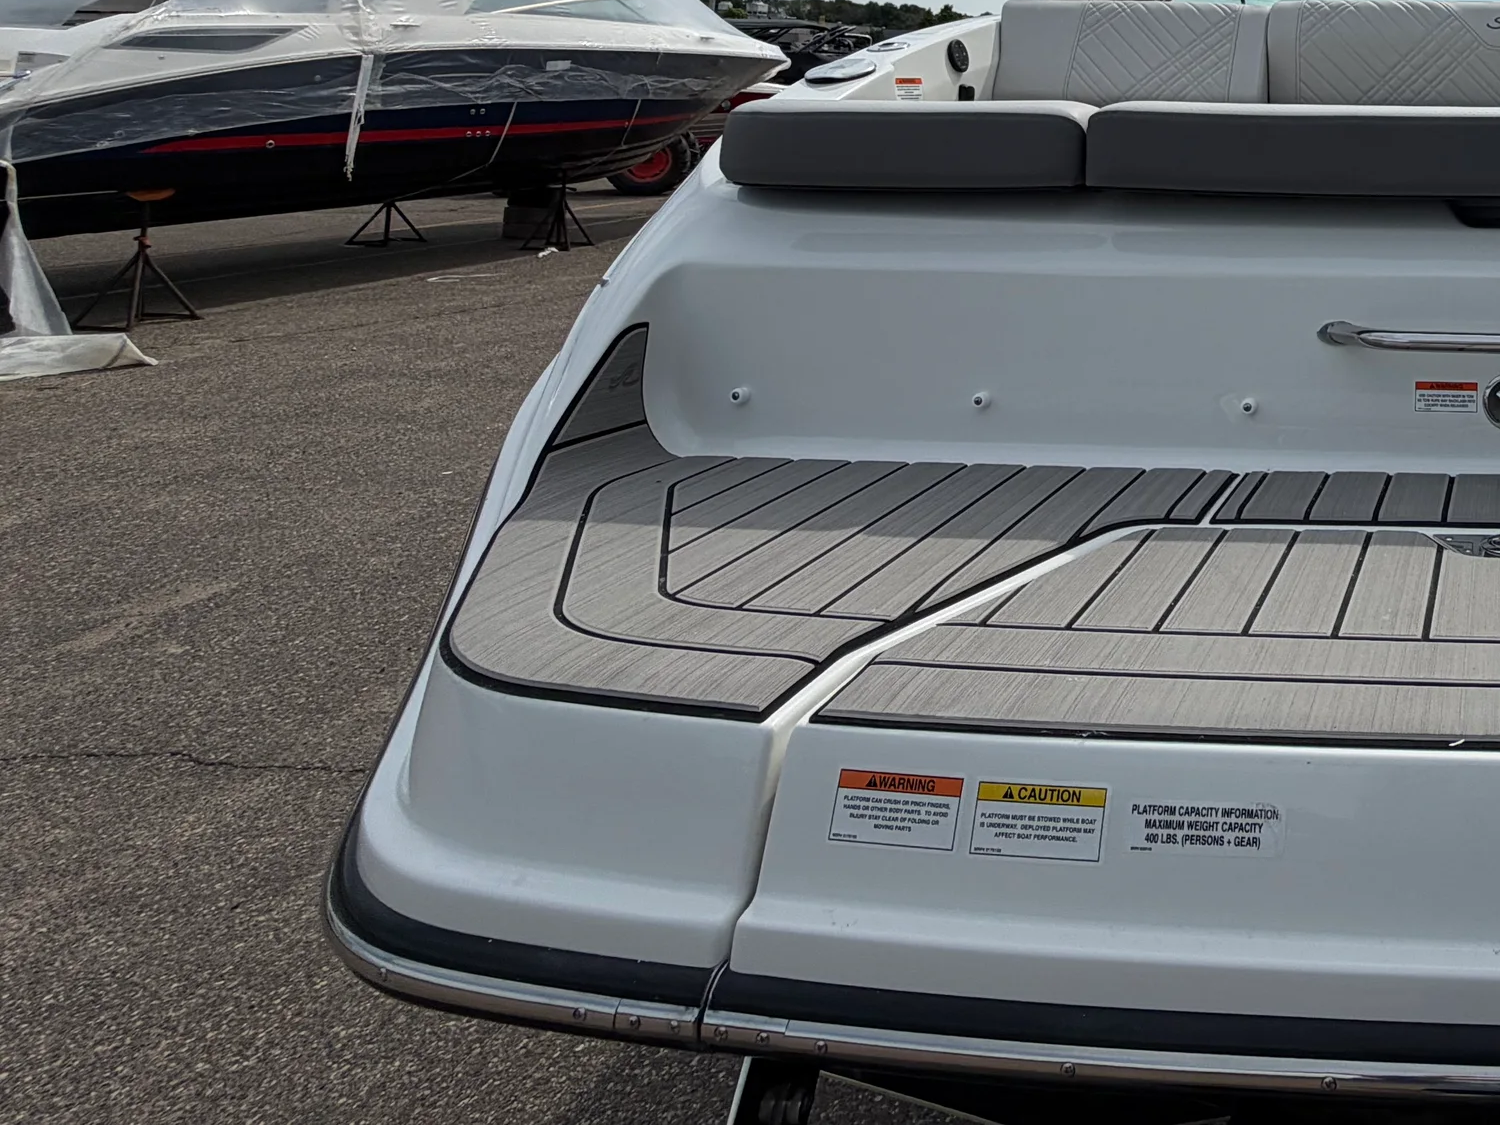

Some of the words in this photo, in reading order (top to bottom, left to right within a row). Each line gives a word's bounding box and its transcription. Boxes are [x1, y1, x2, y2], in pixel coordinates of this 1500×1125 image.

[880, 776, 935, 792] WARNING
[1018, 786, 1081, 803] CAUTION
[1132, 804, 1176, 816] PLATFORM
[1178, 806, 1219, 818] CAPACITY
[1221, 808, 1279, 819] INFORMATION
[874, 823, 893, 831] MOVING
[908, 817, 930, 825] FOLDING
[1145, 819, 1184, 830] MAXIMUM
[1187, 820, 1219, 831] WEIGHT
[1221, 823, 1263, 833] CAPACITY
[994, 831, 1016, 839] AFFECT
[1145, 833, 1159, 843] 400
[1161, 834, 1179, 844] LBS.
[1182, 834, 1224, 847] (PERSONS
[1234, 836, 1261, 850] GEAR)
